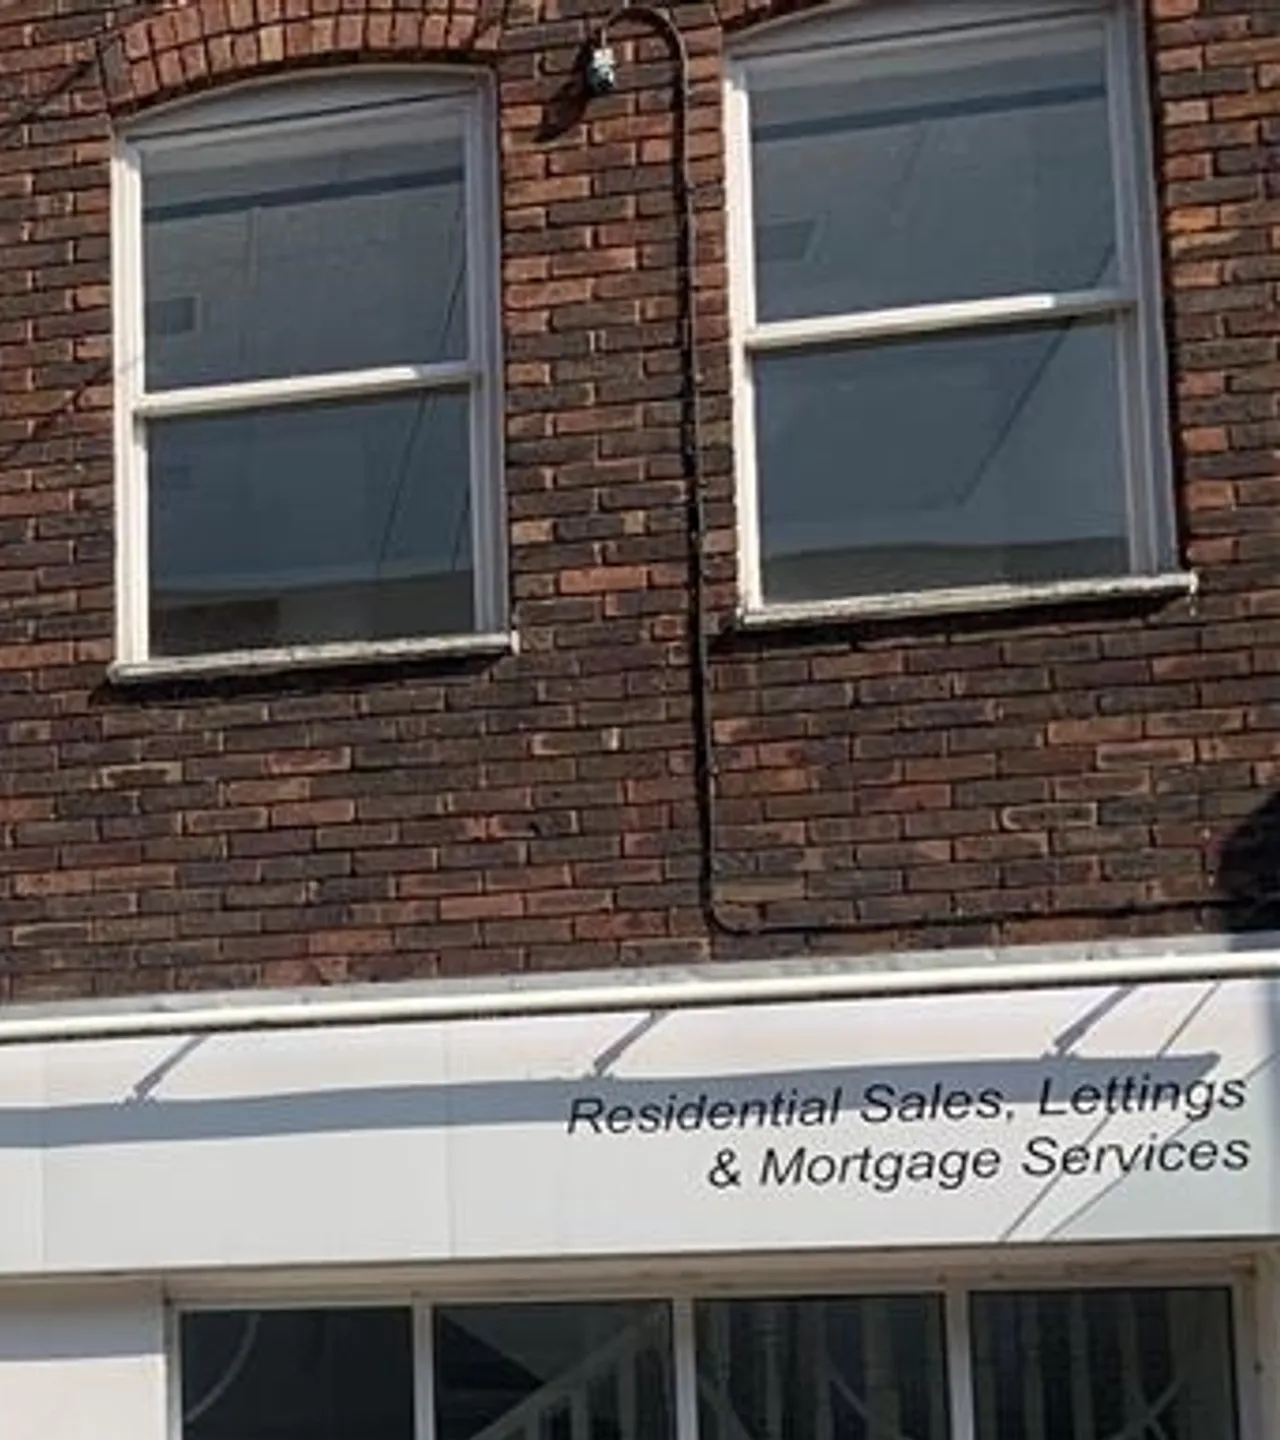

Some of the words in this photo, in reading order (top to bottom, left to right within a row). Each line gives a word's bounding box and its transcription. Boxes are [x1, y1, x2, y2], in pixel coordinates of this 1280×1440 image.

[567, 1088, 842, 1135] Residential
[860, 1079, 1015, 1124] Sales,
[1039, 1072, 1248, 1120] Lettings
[708, 1150, 740, 1188] &
[758, 1145, 1002, 1192] Mortgage
[1021, 1134, 1251, 1178] Services
